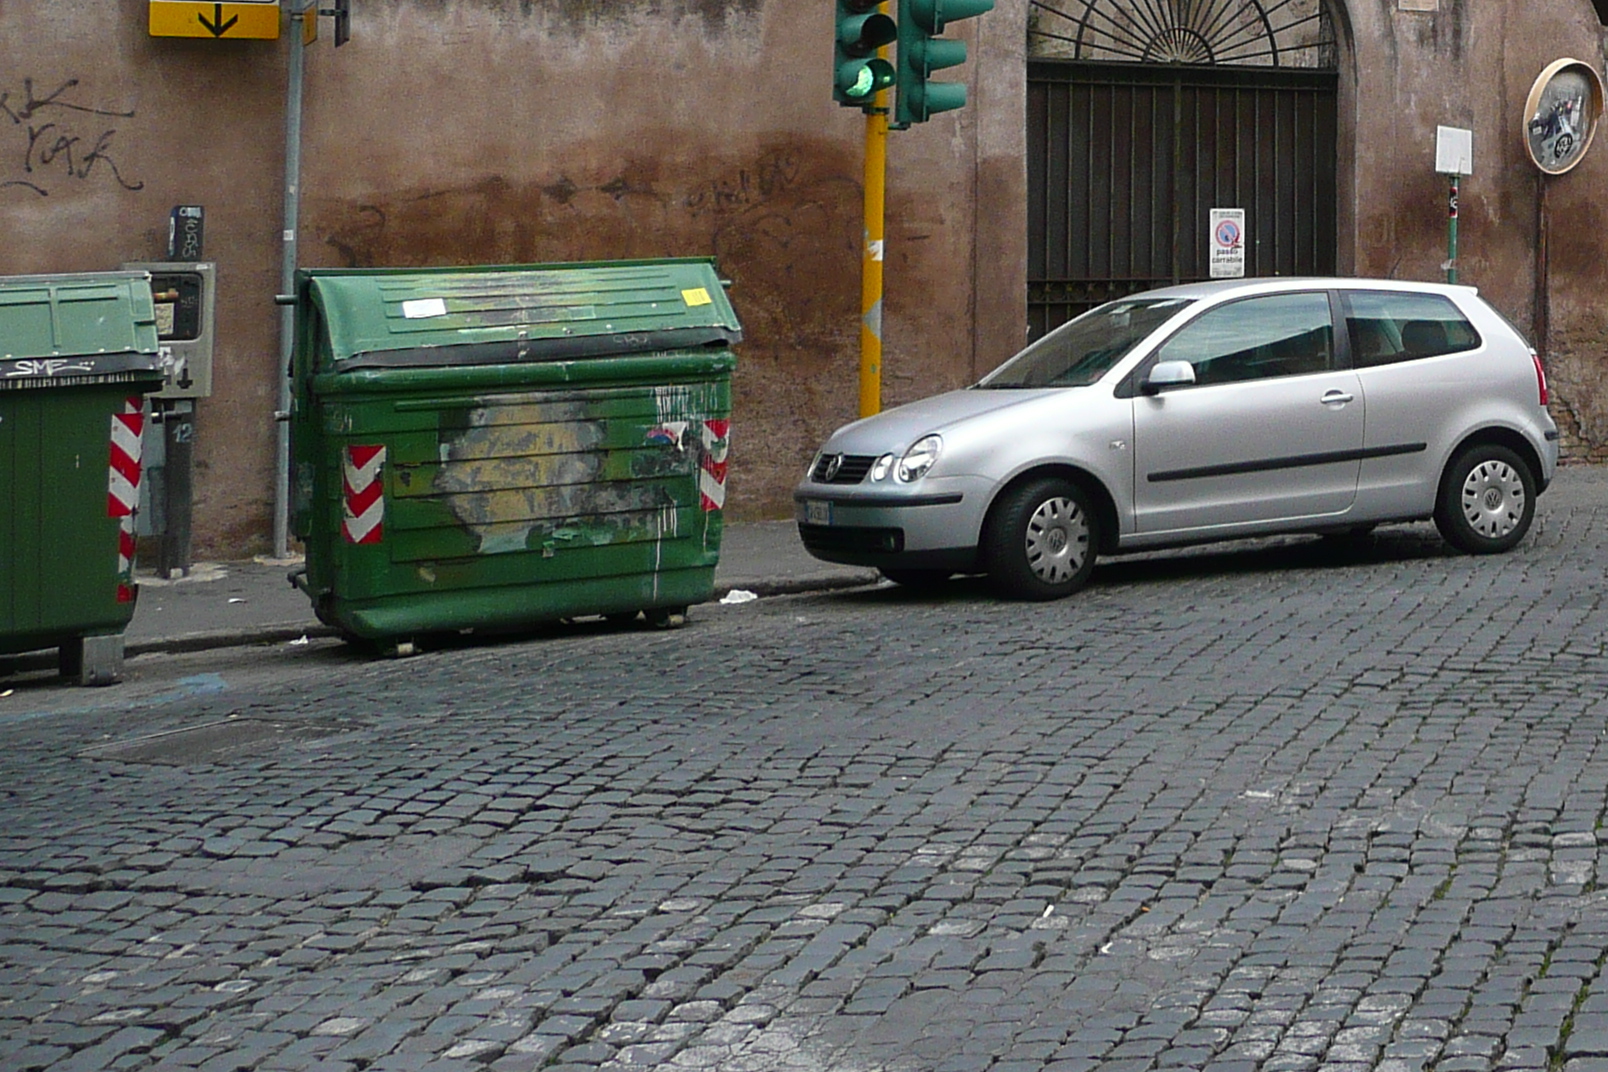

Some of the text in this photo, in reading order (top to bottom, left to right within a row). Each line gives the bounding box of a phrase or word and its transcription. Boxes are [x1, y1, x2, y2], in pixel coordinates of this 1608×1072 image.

[1216, 248, 1239, 256] passo
[1211, 256, 1243, 264] carrabile
[172, 422, 193, 444] 12
